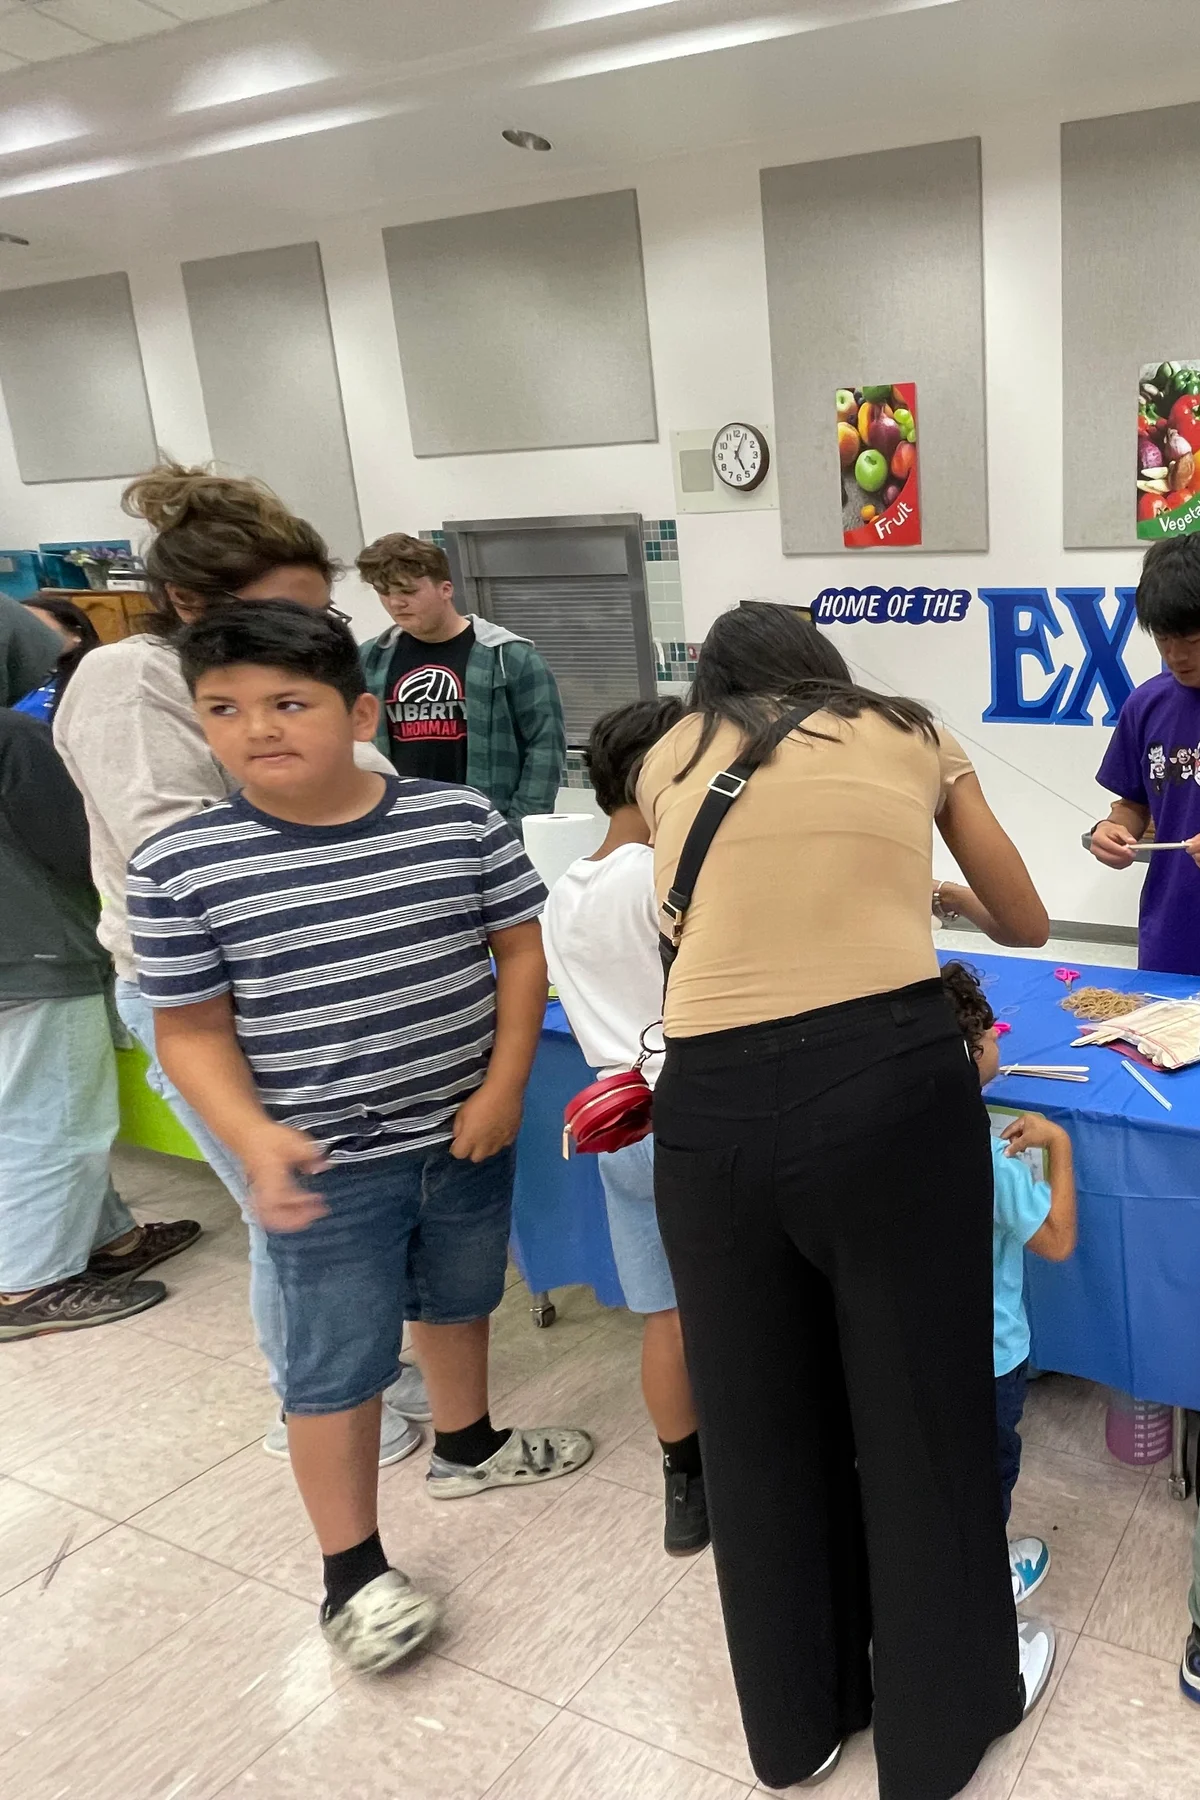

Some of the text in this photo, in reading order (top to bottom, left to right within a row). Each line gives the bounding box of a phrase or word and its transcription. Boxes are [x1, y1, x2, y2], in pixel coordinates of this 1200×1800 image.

[726, 433, 732, 441] 11
[733, 430, 740, 438] 12
[720, 442, 728, 450] 10
[752, 451, 758, 459] 3
[750, 462, 756, 470] 4
[728, 471, 733, 479] 7
[744, 470, 750, 478] 5
[874, 502, 913, 540] Fruit
[818, 594, 964, 617] HOME OF THE
